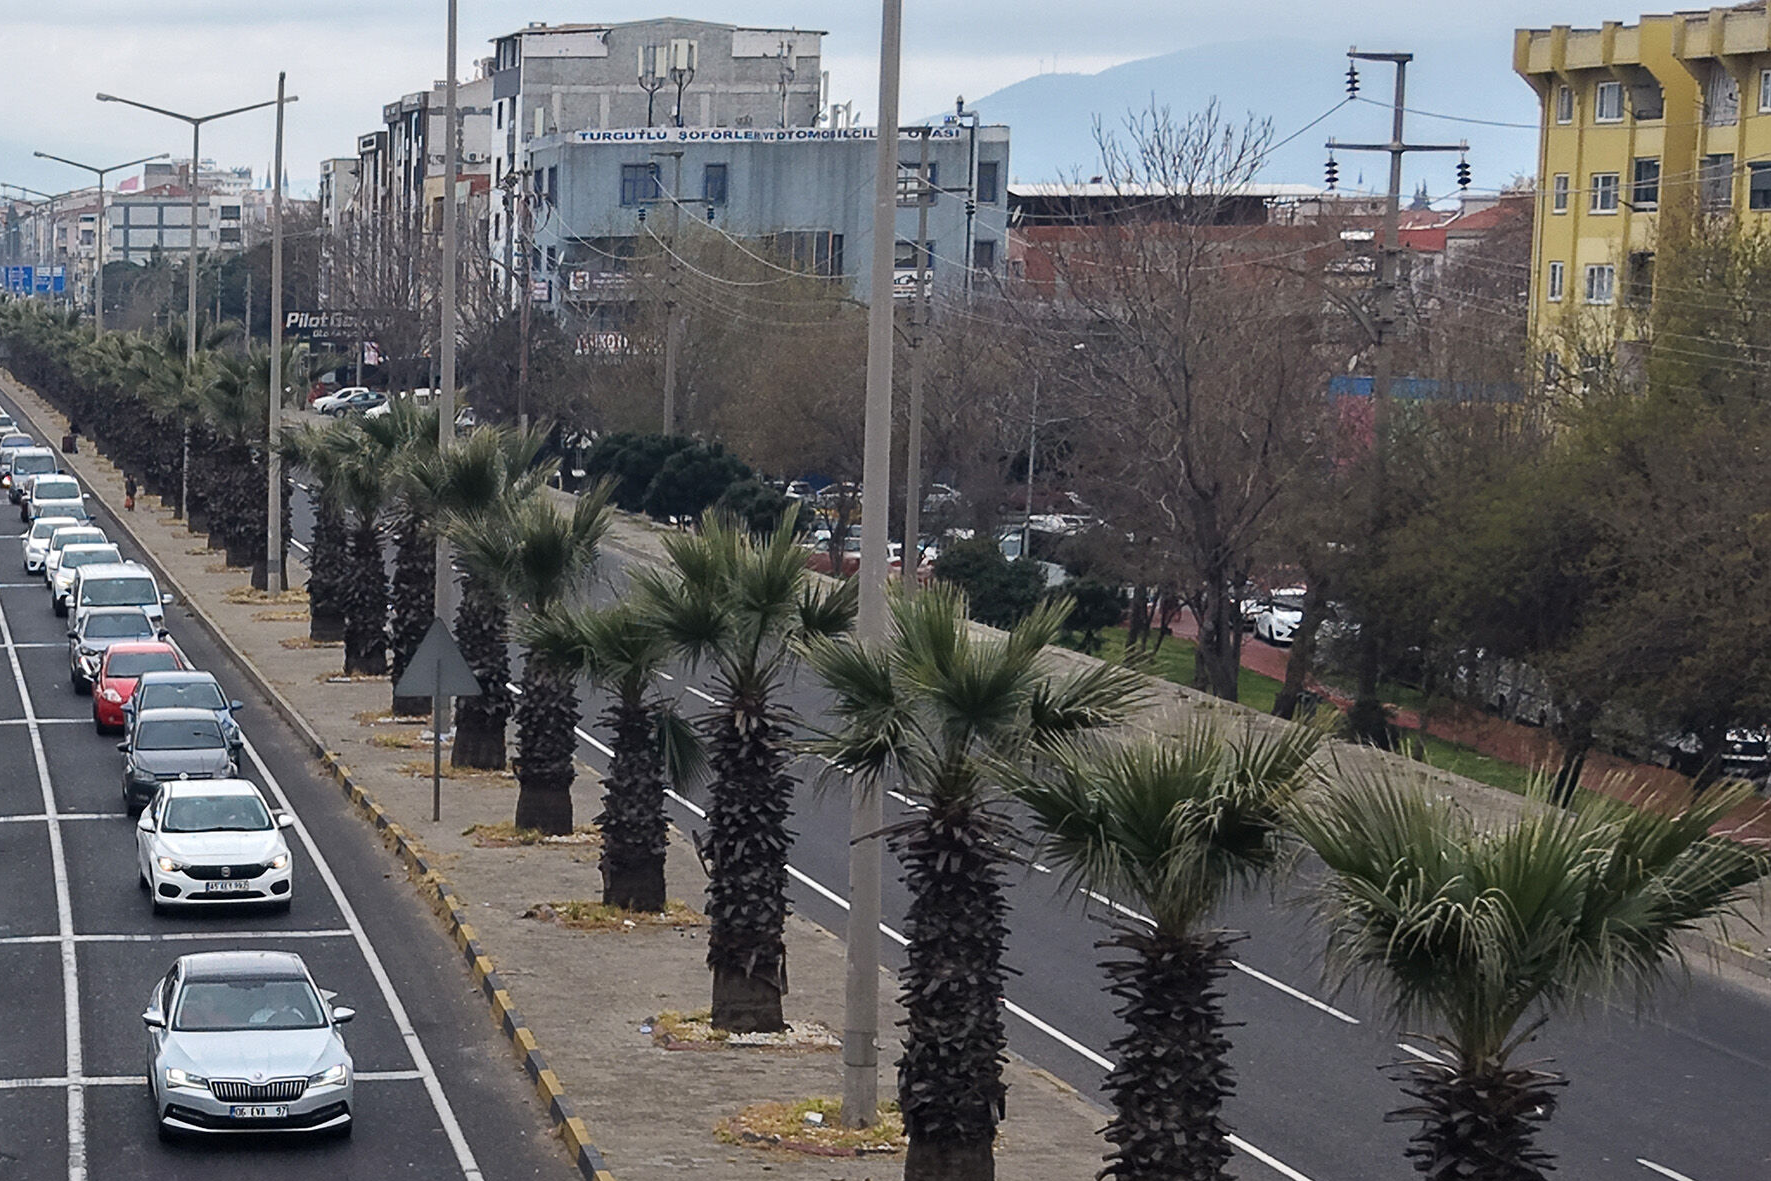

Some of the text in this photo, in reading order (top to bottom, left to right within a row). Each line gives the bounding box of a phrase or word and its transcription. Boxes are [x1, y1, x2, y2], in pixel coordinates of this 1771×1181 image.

[579, 130, 667, 141] TURGUTLU
[776, 128, 900, 140] OTOMOBİLCİL
[908, 128, 960, 139] OASI
